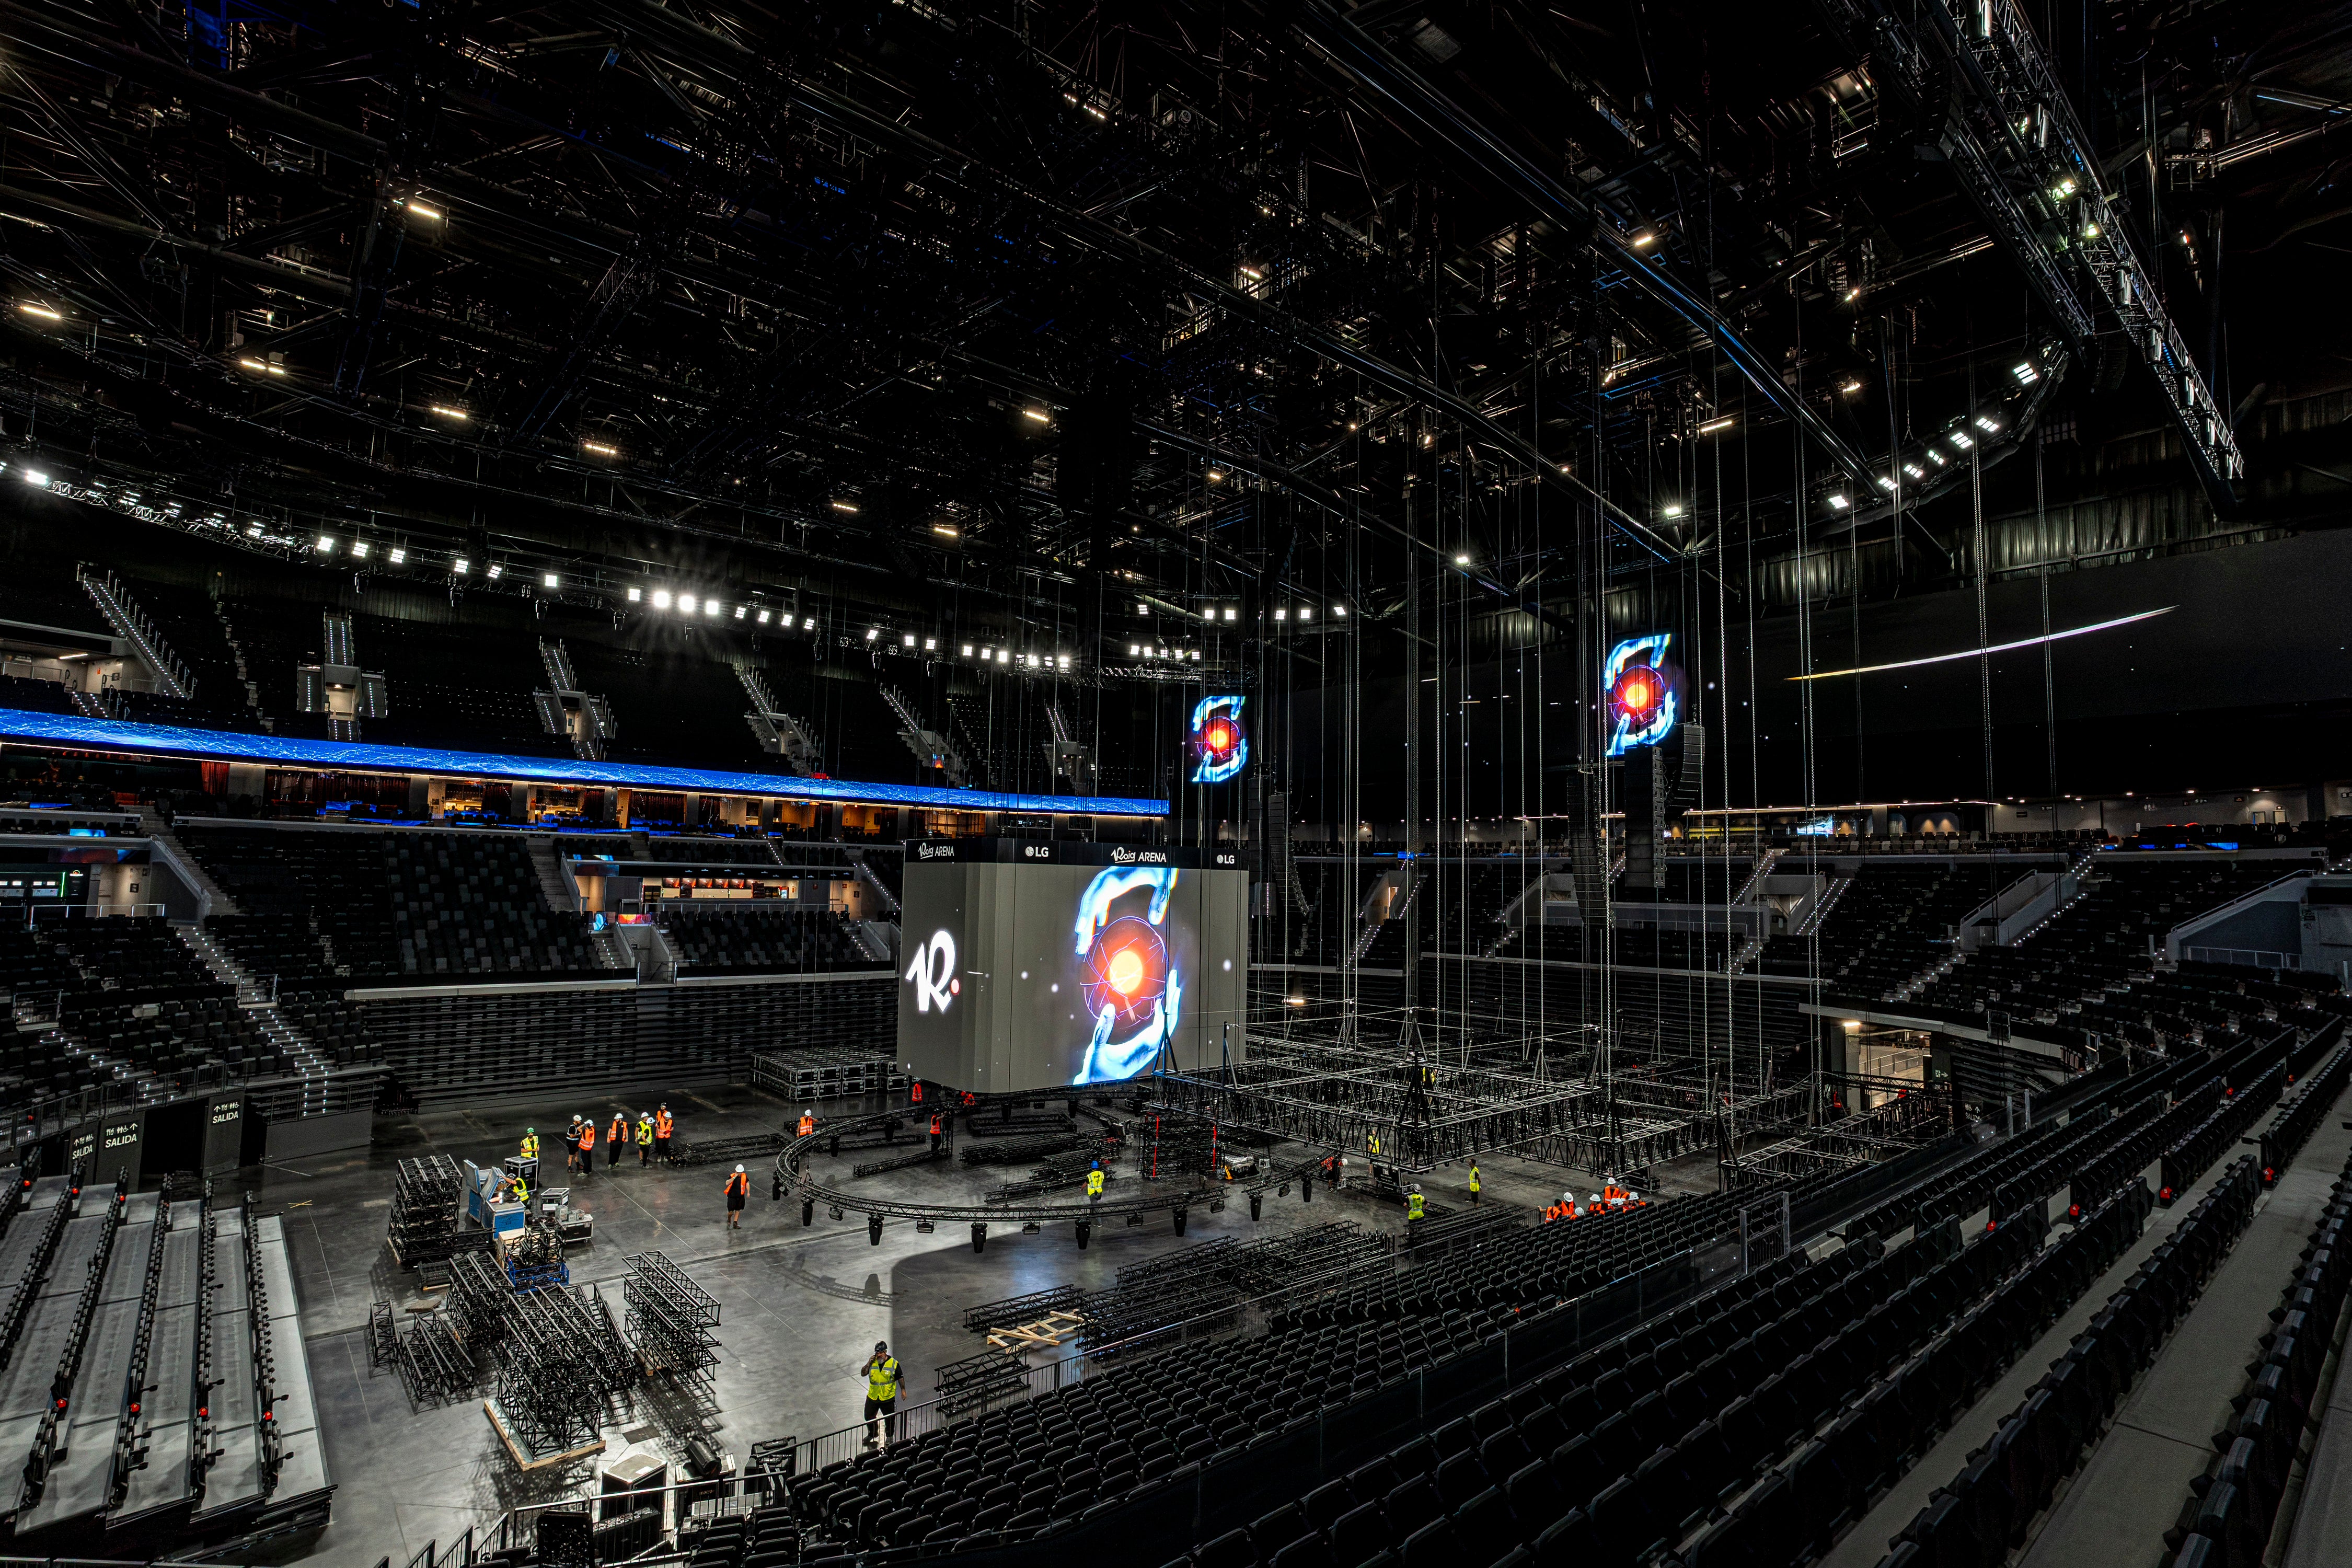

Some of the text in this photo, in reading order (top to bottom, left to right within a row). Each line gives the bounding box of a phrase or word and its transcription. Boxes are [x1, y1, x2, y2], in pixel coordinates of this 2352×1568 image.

[935, 846, 954, 856] ARENA
[1035, 847, 1048, 857] LG
[1138, 852, 1167, 862] ARENA
[1224, 855, 1235, 864] LG
[213, 1111, 238, 1124] SALIDA
[105, 1134, 137, 1148] SALIDA
[72, 1145, 93, 1160] SALIDA
